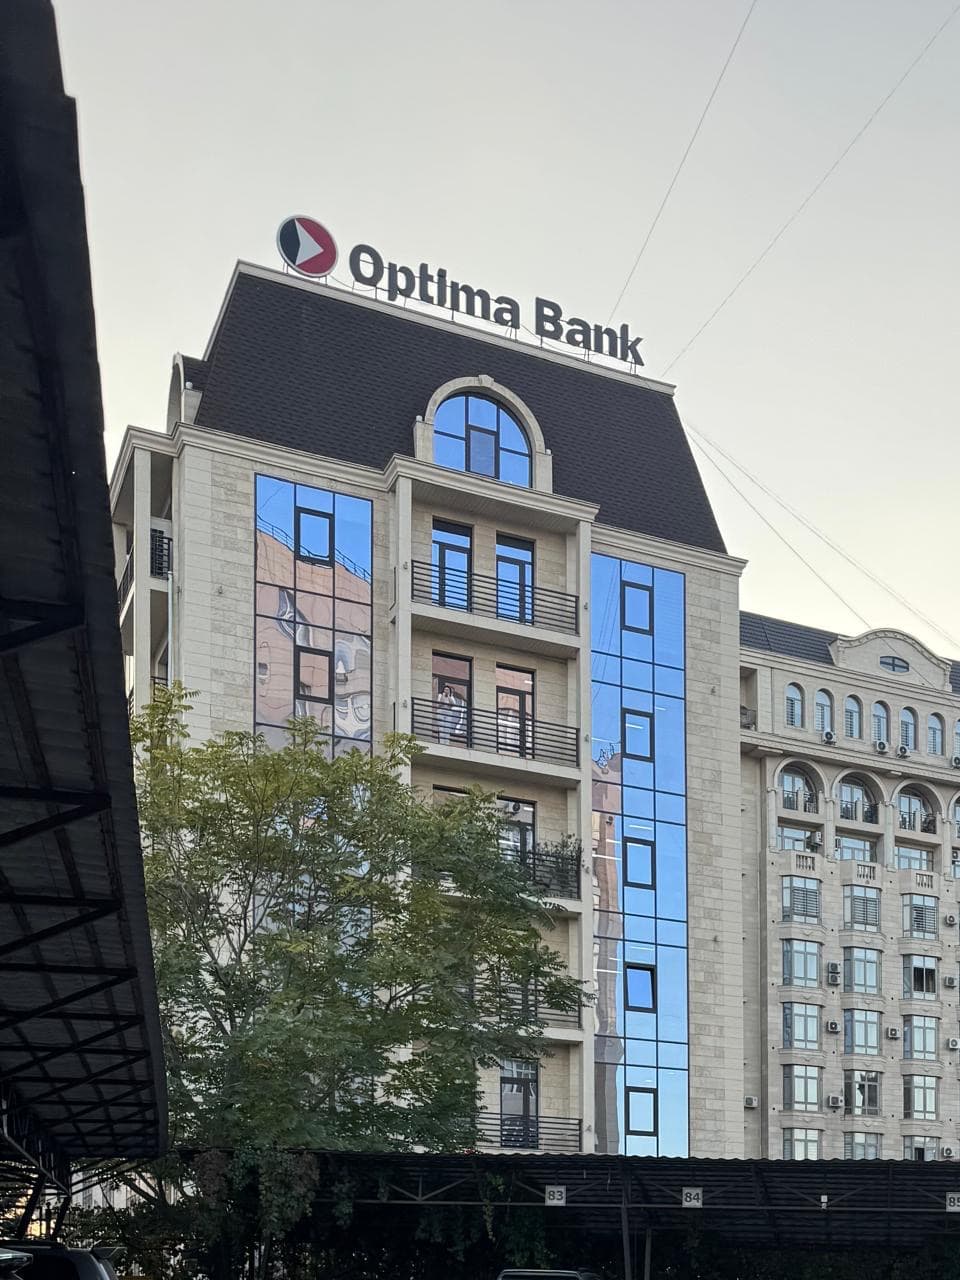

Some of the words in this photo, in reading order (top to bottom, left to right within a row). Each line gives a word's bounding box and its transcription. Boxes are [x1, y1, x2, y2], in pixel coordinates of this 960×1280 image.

[349, 244, 520, 329] Optima
[535, 297, 645, 366] Bank
[548, 1190, 564, 1201] 83
[684, 1192, 700, 1203] 84
